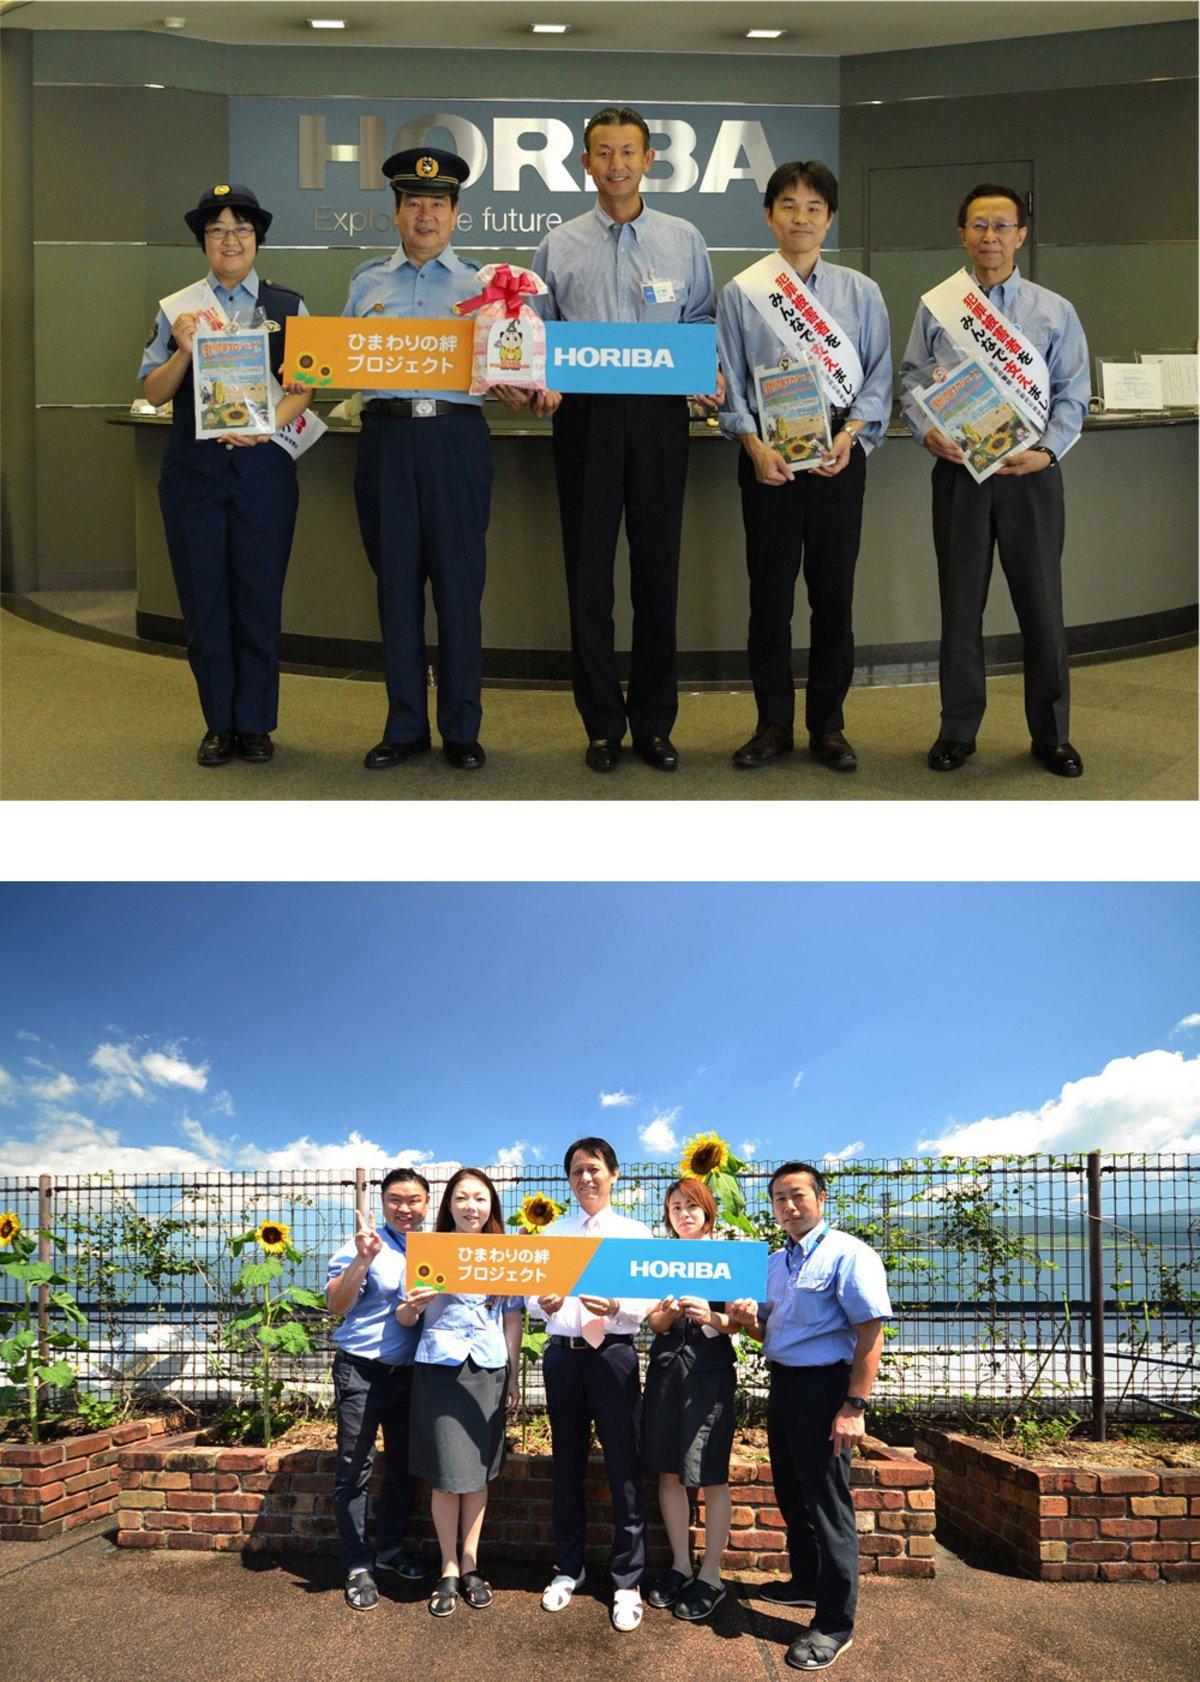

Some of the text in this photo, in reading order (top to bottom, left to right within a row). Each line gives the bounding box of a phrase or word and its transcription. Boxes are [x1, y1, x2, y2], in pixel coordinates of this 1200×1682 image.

[298, 113, 776, 193] HORBA
[314, 204, 391, 237] Explo
[482, 206, 563, 232] future
[774, 272, 841, 348] 犯罪被害者を
[962, 292, 1034, 366] 犯罪被害者を
[347, 333, 458, 353] ひまわりの絆
[347, 354, 454, 375] プロジェクト
[554, 346, 675, 368] HORIBA
[458, 1246, 550, 1265] ひまわりの絆
[458, 1264, 547, 1283] プロジェクト
[629, 1259, 732, 1280] HORIBA
